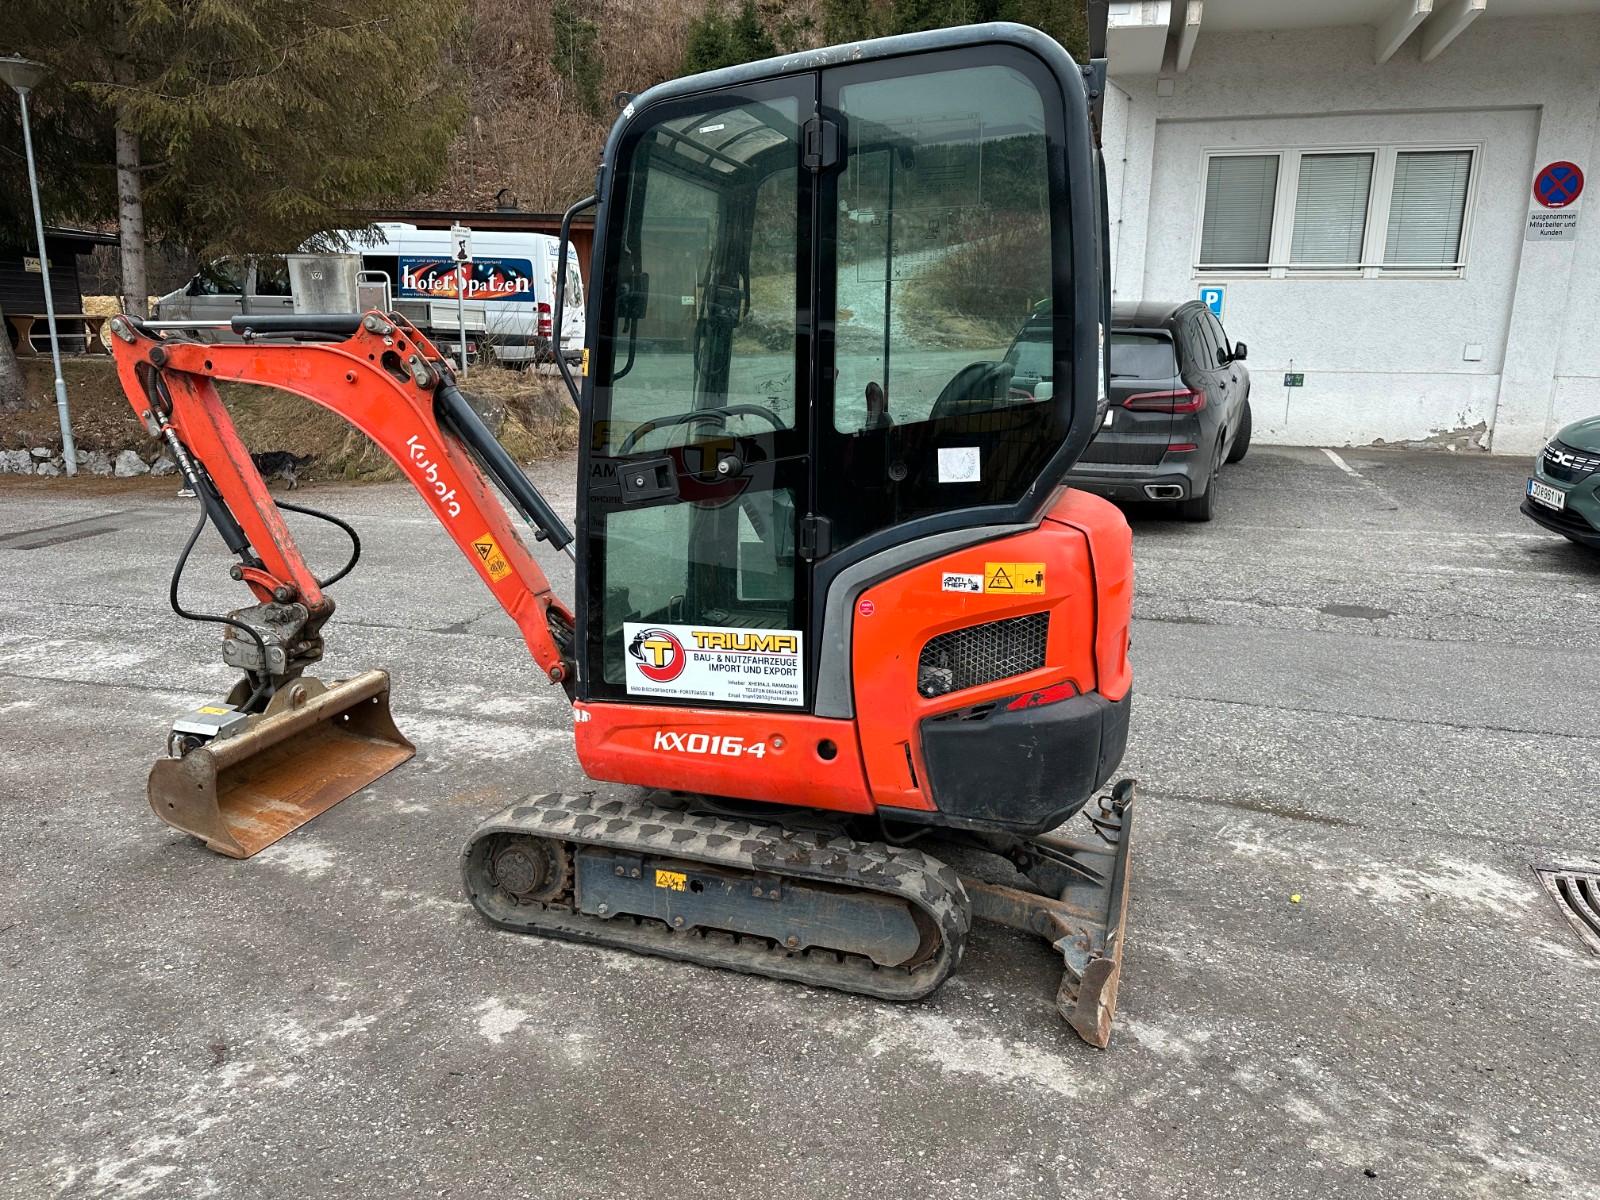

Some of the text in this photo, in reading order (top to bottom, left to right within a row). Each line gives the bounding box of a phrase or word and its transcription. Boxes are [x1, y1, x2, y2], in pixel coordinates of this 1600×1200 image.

[1531, 213, 1576, 221] ausgenommen
[1205, 291, 1218, 309] P
[406, 434, 461, 518] Kubota
[691, 631, 798, 654] TRIUMFI
[643, 640, 673, 668] T
[693, 652, 798, 667] BAU- & NUTZFAHRZEUGE
[708, 664, 798, 676] IMPORT UND EXPORT
[653, 731, 766, 758] KX016-4
